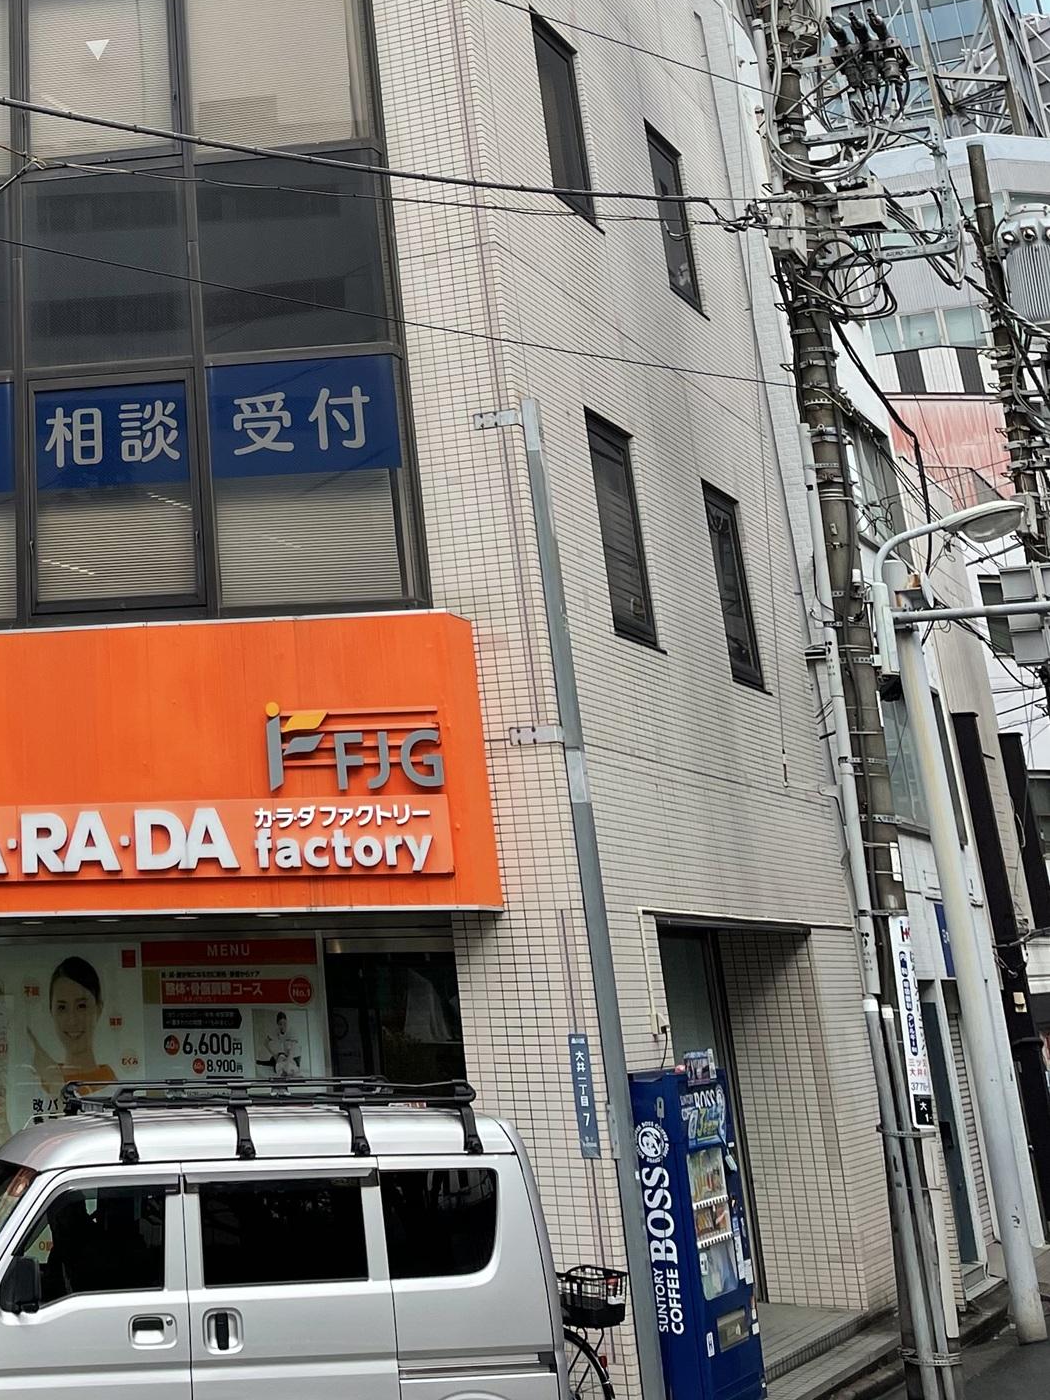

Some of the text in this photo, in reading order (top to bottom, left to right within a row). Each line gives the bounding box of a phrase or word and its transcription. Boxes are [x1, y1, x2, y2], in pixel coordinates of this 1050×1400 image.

[45, 400, 180, 468] 相談
[233, 385, 370, 455] 受付
[333, 728, 445, 791] FJG
[254, 827, 433, 872] factory
[206, 944, 251, 957] MENU
[575, 1050, 590, 1107] 大井一丁目
[583, 1112, 591, 1127] 7
[641, 1166, 678, 1265] BOSS
[653, 1267, 669, 1333] SUNTORY
[666, 1268, 685, 1336] COFFEE
